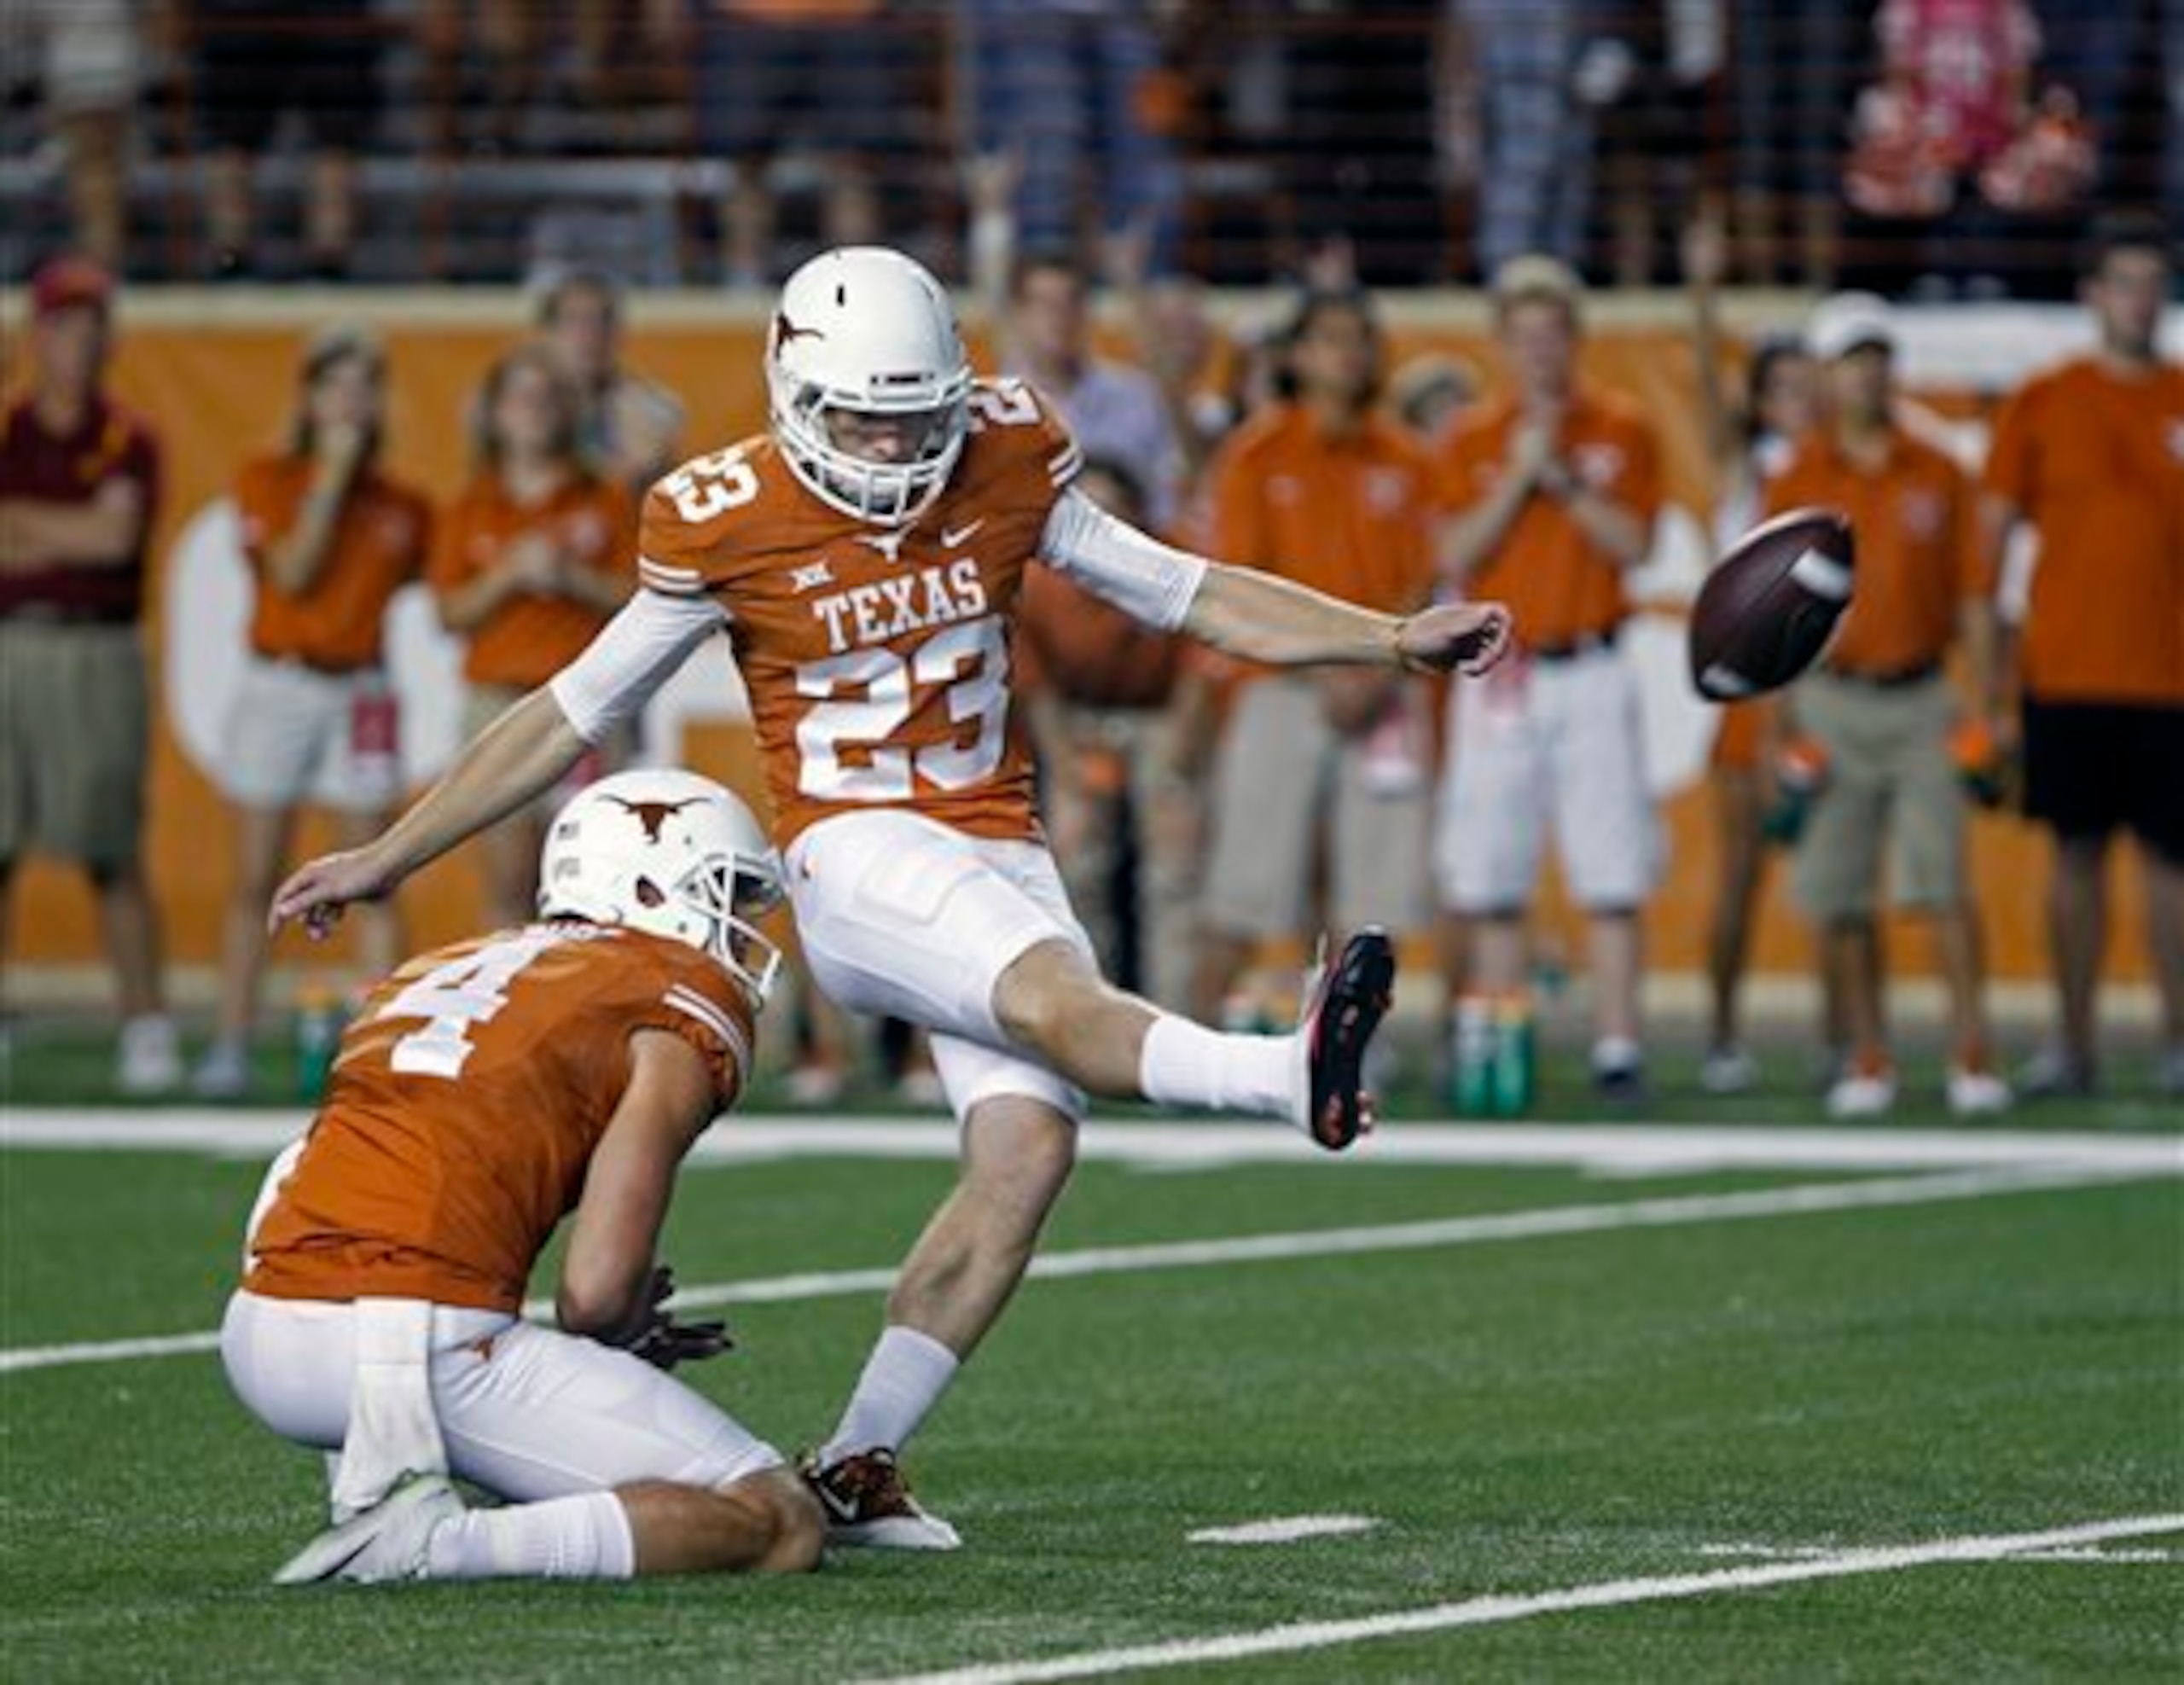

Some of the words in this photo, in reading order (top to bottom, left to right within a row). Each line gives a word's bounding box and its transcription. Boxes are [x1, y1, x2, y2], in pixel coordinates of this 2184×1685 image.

[813, 557, 987, 654] TEXAS
[796, 613, 1009, 799] 23
[375, 927, 548, 1079] 4
